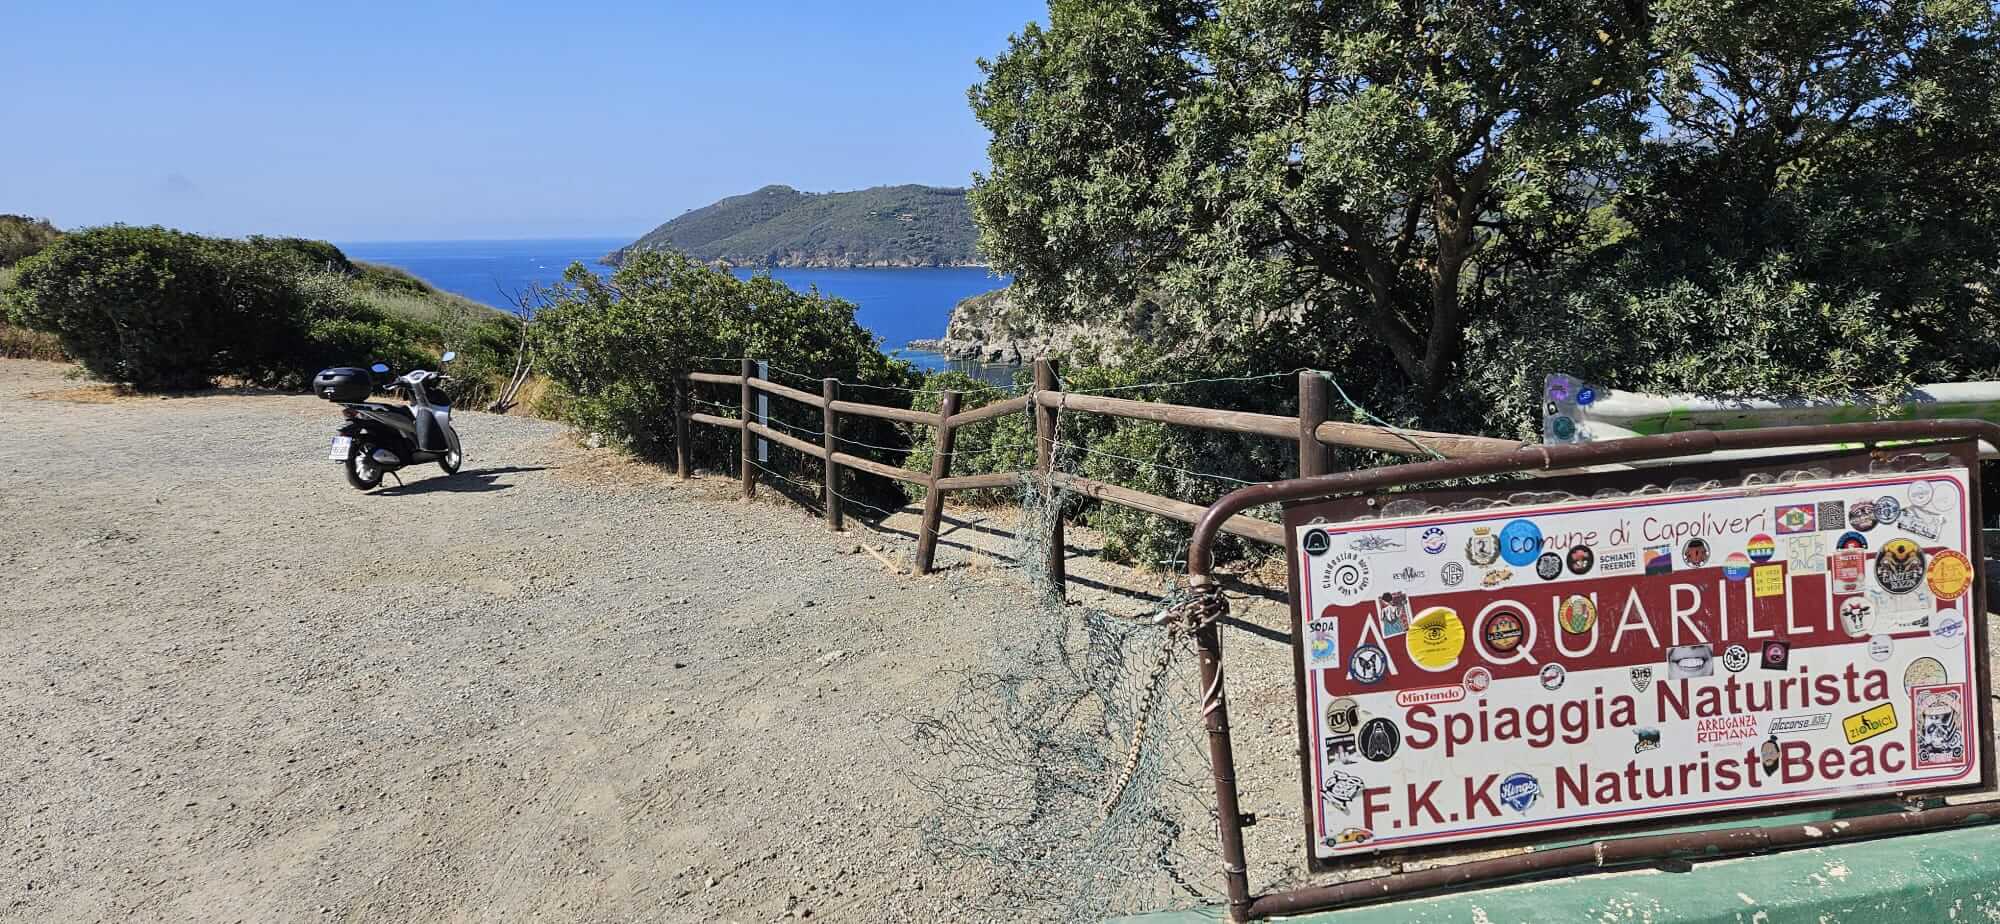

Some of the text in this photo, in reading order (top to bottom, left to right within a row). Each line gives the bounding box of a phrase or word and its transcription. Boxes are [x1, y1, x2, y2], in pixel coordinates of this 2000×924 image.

[1609, 518, 1631, 546] di
[1642, 508, 1767, 546] Capoliveri
[1599, 552, 1636, 564] SCHIANTI
[1600, 561, 1636, 572] FREERIDE
[1309, 620, 1335, 632] SODA
[1402, 689, 1460, 703] Mintendo
[1404, 662, 1890, 757] Spiaggia Naturista
[1697, 715, 1758, 732] ARROGANZA
[1697, 727, 1758, 744] ROMANA
[1555, 751, 1762, 808] Naturist
[1780, 740, 1910, 786] Beac
